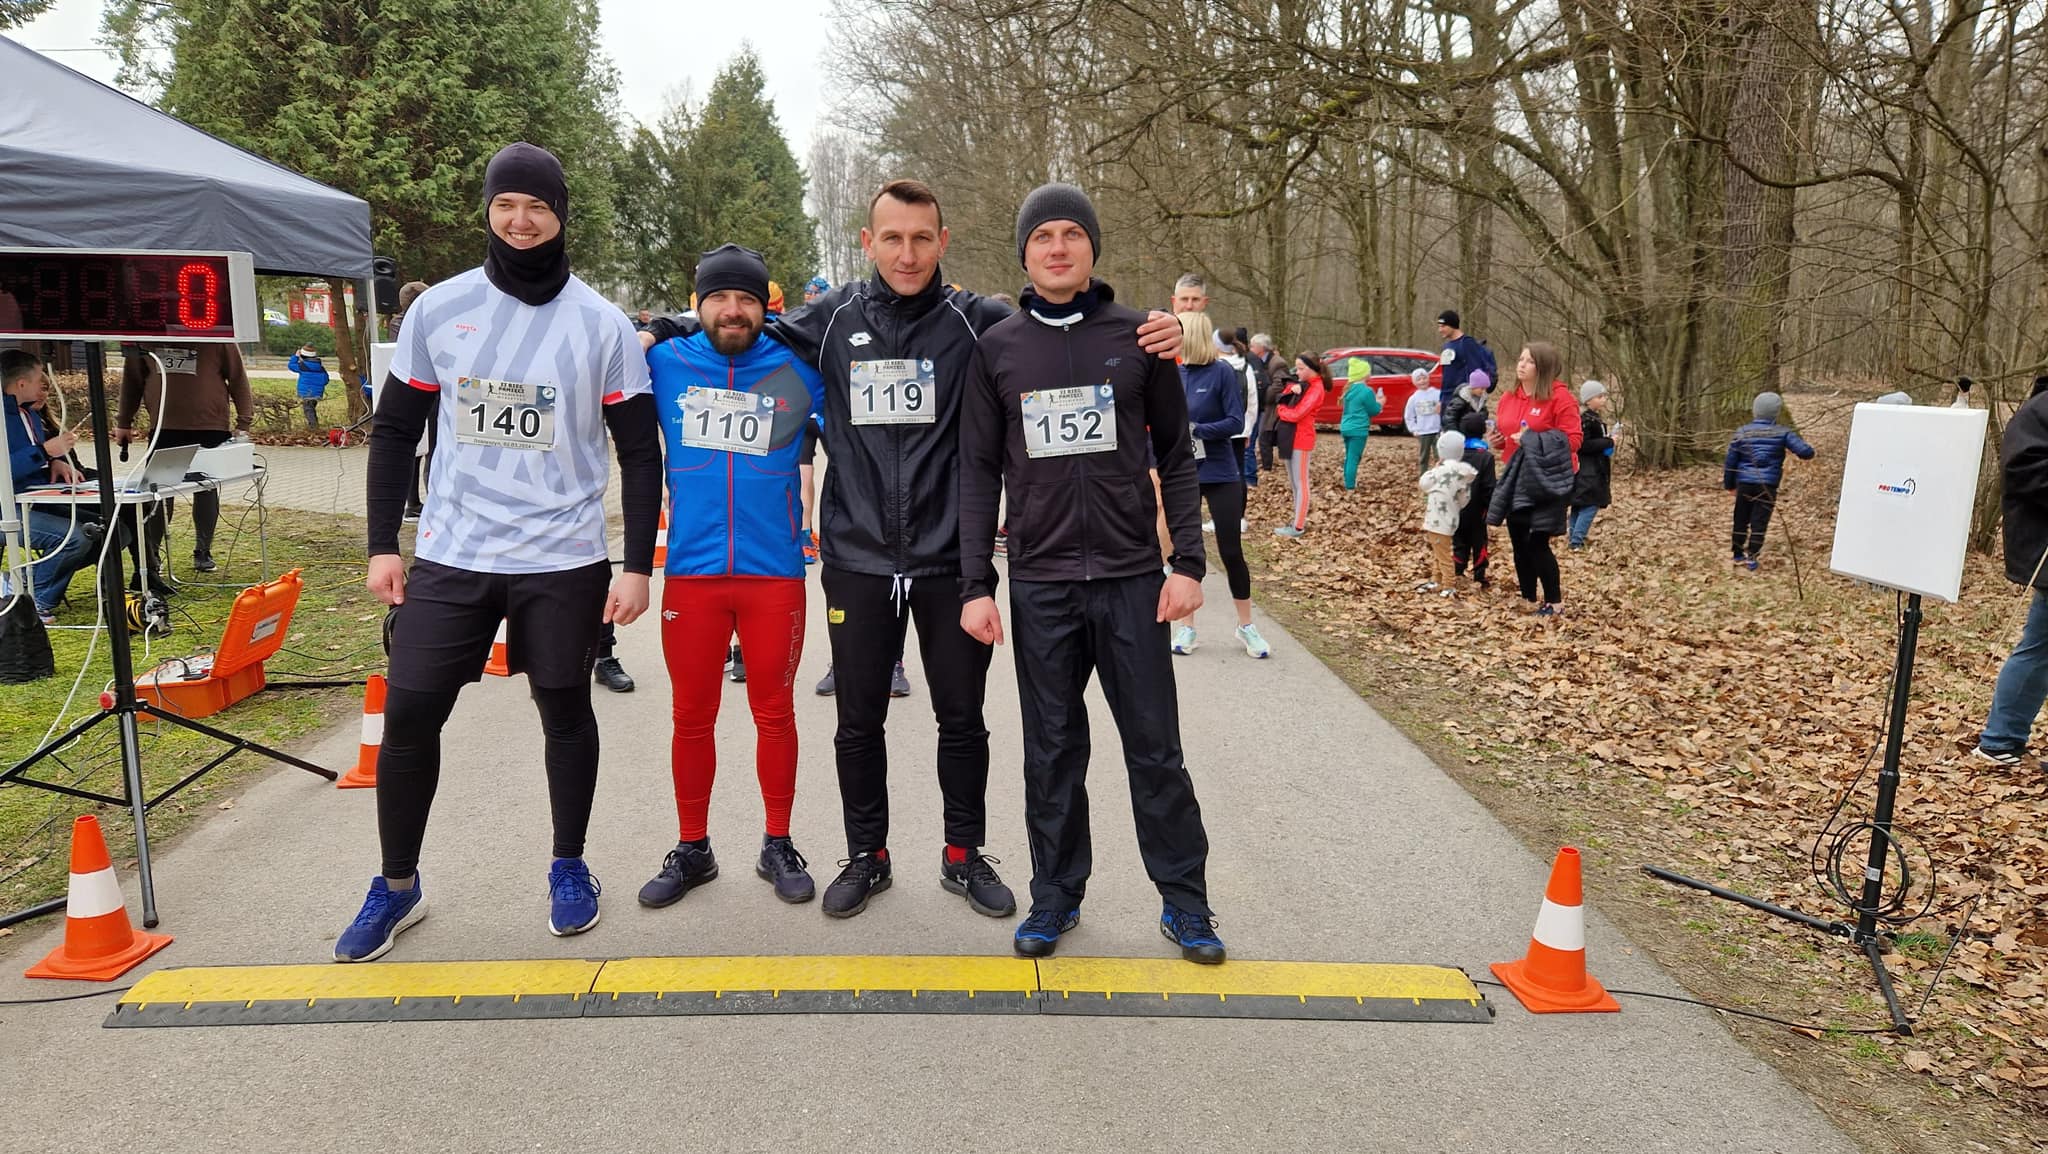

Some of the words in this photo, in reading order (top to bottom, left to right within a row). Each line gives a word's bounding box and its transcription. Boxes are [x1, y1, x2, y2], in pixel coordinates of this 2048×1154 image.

[176, 263, 218, 330] 0
[862, 383, 923, 412] 119
[470, 403, 541, 438] 140
[696, 409, 760, 443] 110
[1036, 410, 1103, 444] 152
